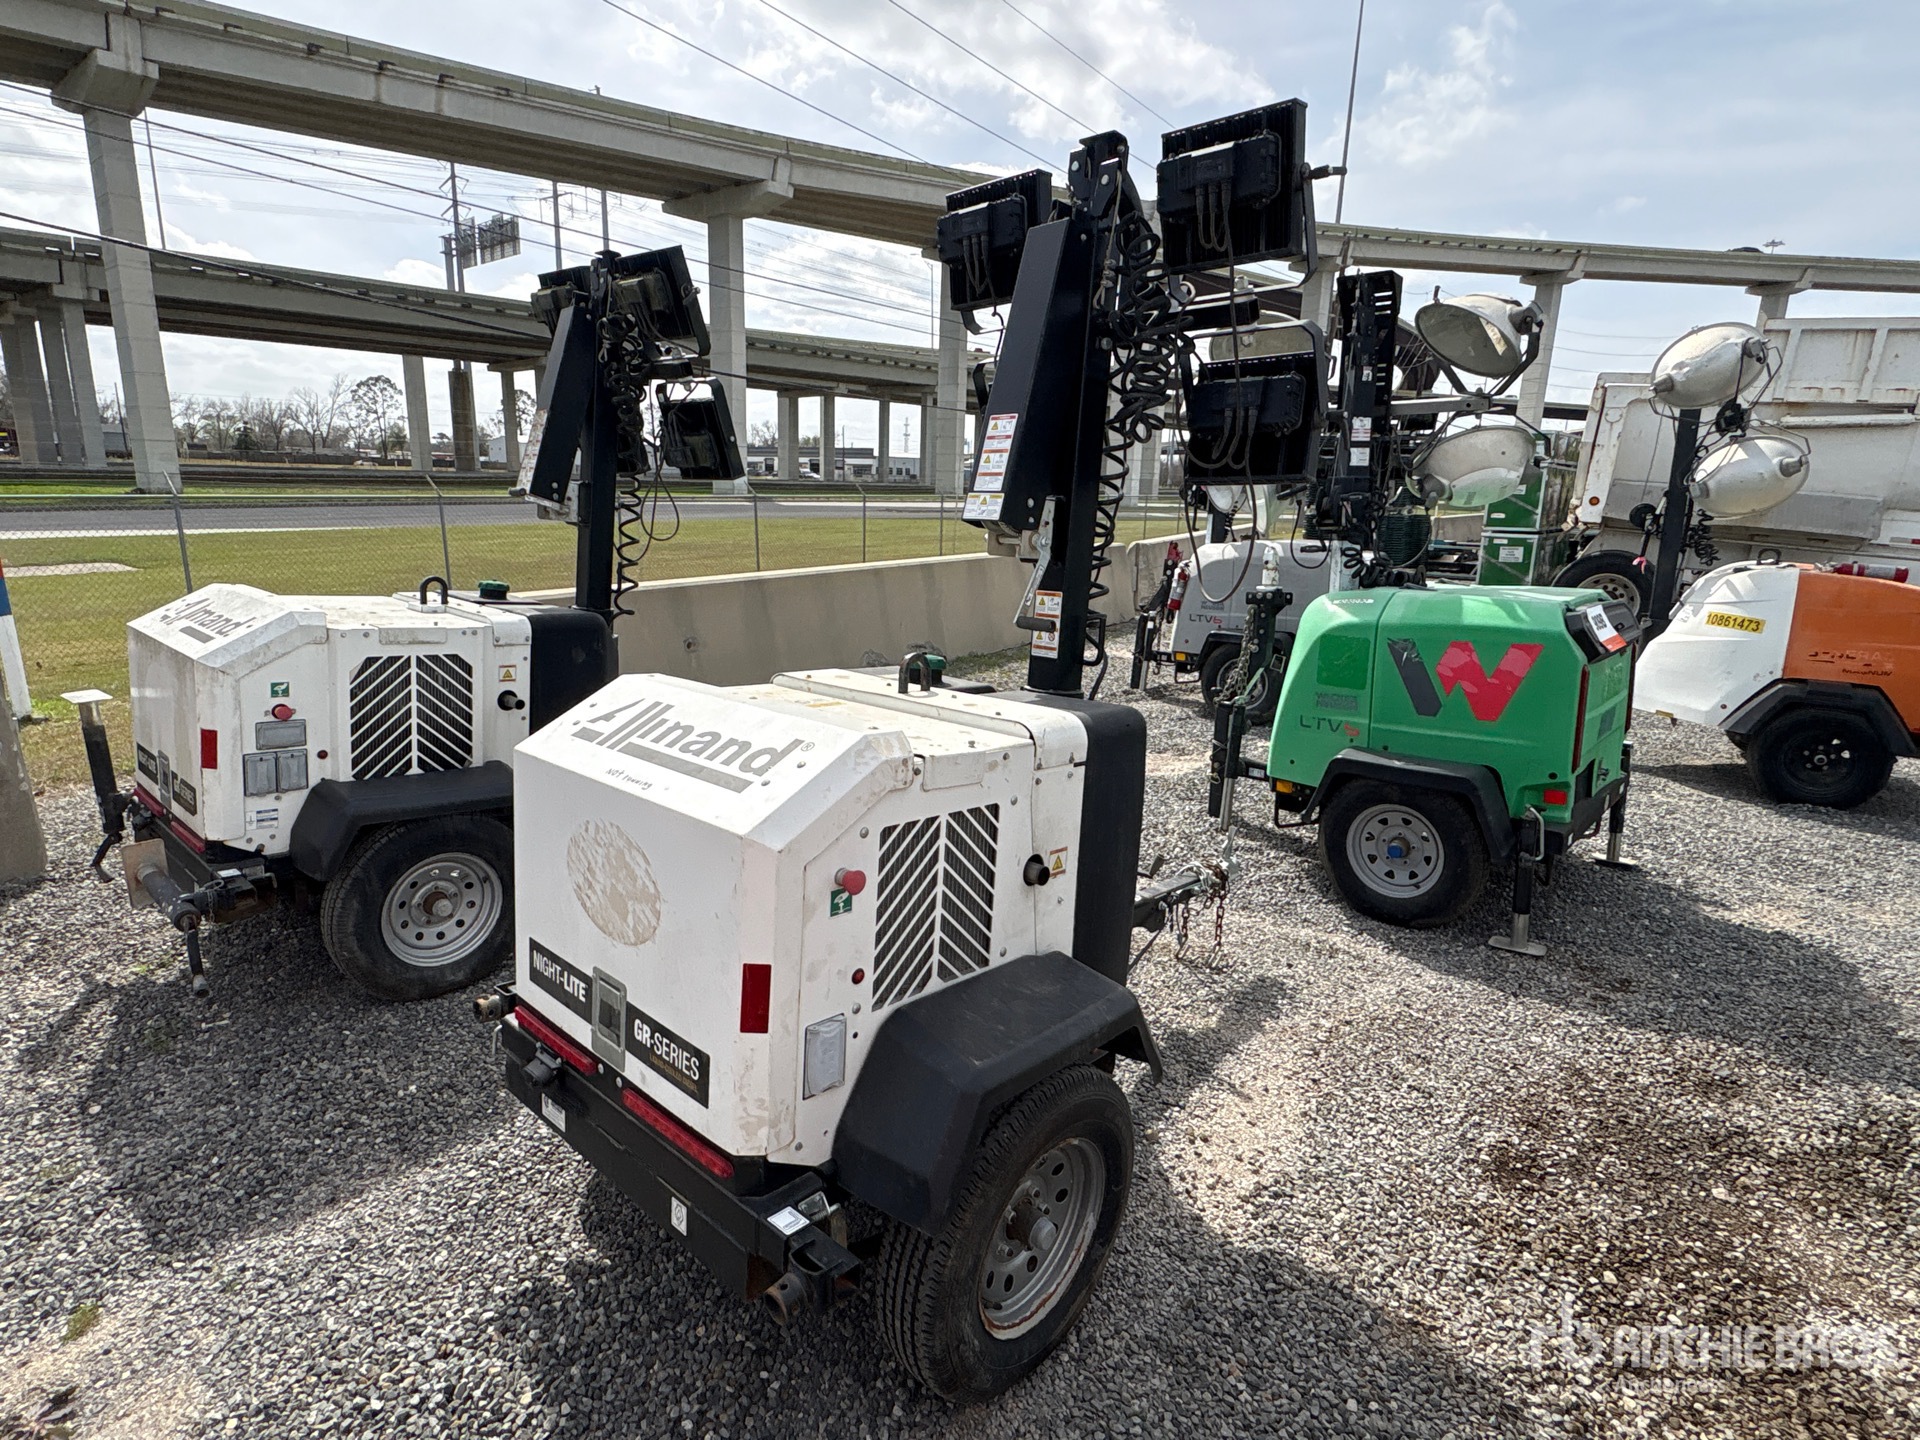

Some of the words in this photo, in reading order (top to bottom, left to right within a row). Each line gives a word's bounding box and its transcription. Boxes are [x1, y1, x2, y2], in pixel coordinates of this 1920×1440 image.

[1706, 613, 1761, 632] 10861473
[532, 950, 586, 1002] NIGHT-LITE
[633, 1018, 700, 1082] GR-SERIES
